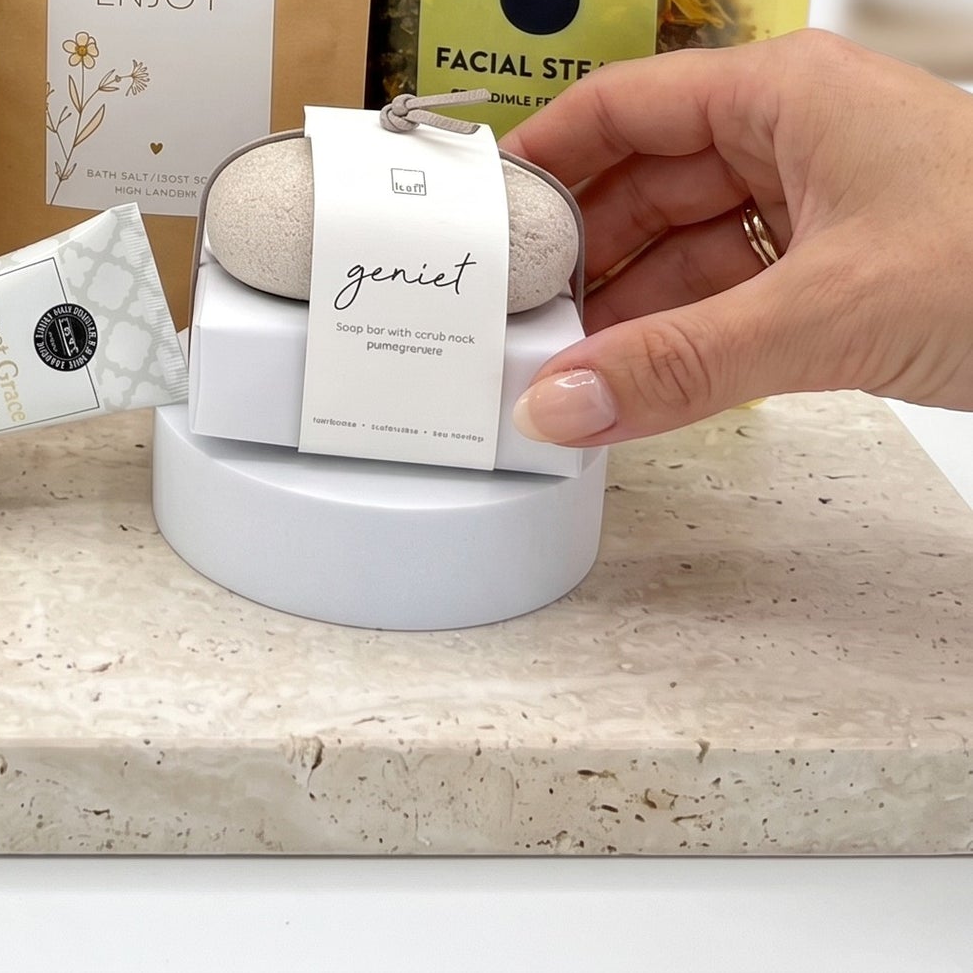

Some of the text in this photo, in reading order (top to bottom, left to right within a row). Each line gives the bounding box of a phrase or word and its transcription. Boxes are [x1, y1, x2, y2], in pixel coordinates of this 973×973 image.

[436, 47, 532, 78] FACIAL
[86, 169, 117, 179] BATH
[333, 252, 477, 311] geniet
[336, 322, 364, 335] Soap
[387, 328, 412, 338] with
